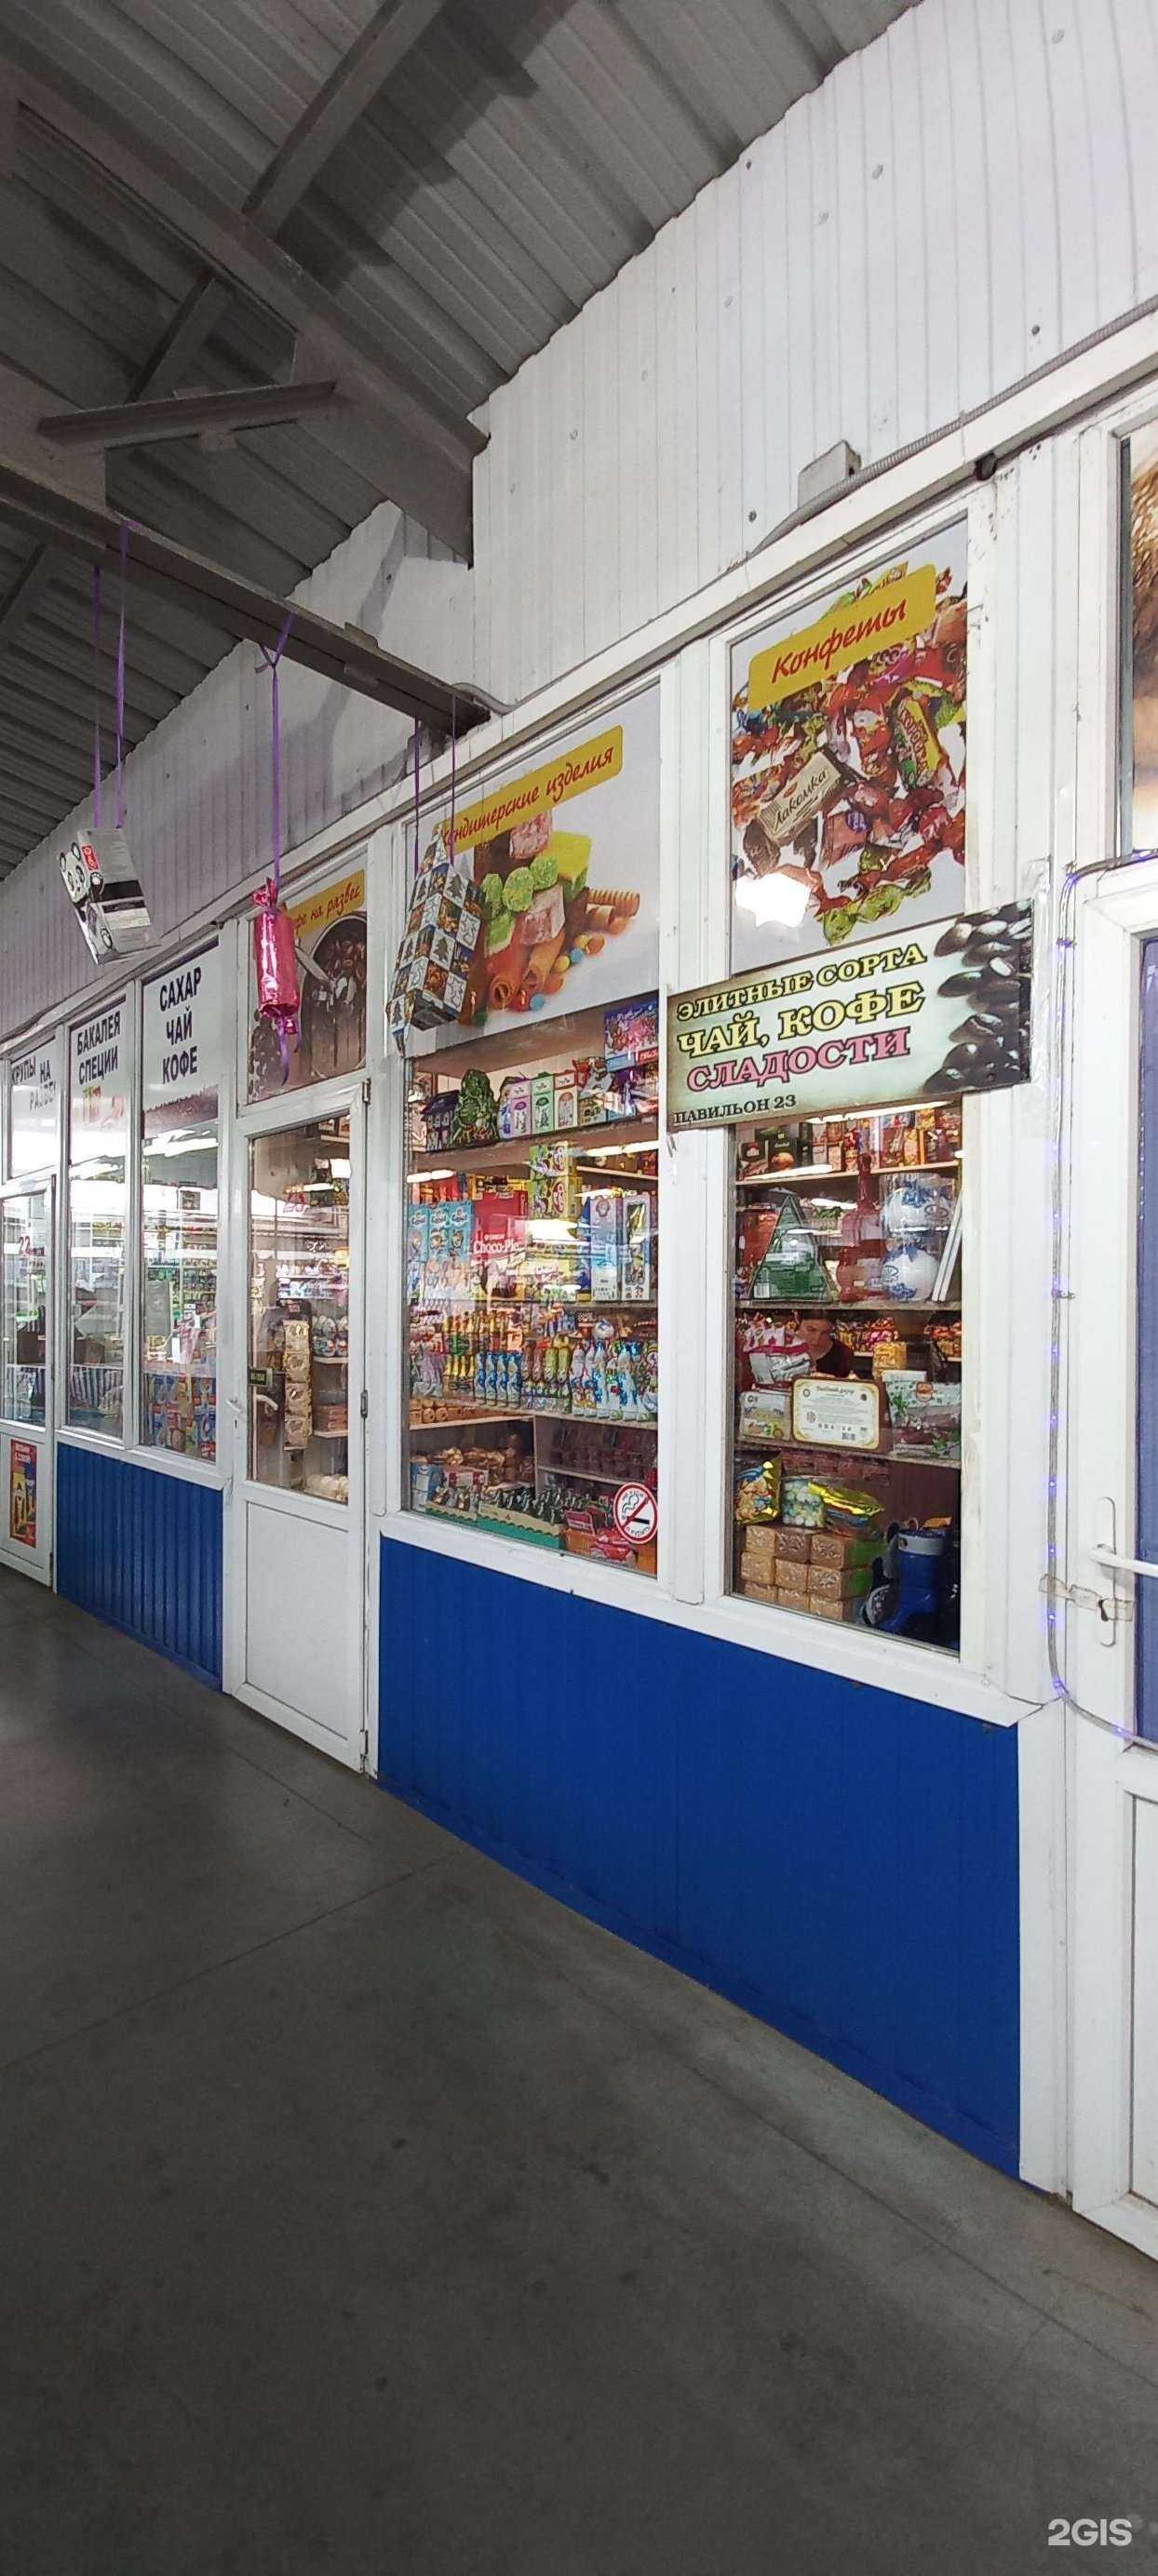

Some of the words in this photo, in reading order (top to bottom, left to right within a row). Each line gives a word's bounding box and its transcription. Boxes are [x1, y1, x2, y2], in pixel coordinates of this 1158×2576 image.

[771, 599, 907, 684] Конфеты
[442, 785, 540, 847] Кндитерские
[545, 745, 613, 802] изделия
[774, 769, 827, 832] Лакомка
[159, 966, 202, 1012] САХАР
[677, 972, 813, 1021] ЭЛИТНЫЕ
[816, 944, 927, 986] СОРТА
[76, 1011, 121, 1056] БАКАЛЕЯ
[167, 1006, 193, 1046] ЧАЙ
[677, 1013, 769, 1059] ЧАЙ,
[778, 982, 924, 1040] КОФЕ
[39, 1059, 51, 1084] НА
[78, 1044, 118, 1085] СПЕЦИИ
[162, 1045, 198, 1084] КОФЕ
[687, 1026, 911, 1093] СЛАДОСТИ
[674, 1098, 770, 1124] ПАВИЛЬОН
[774, 1093, 797, 1111] 23
